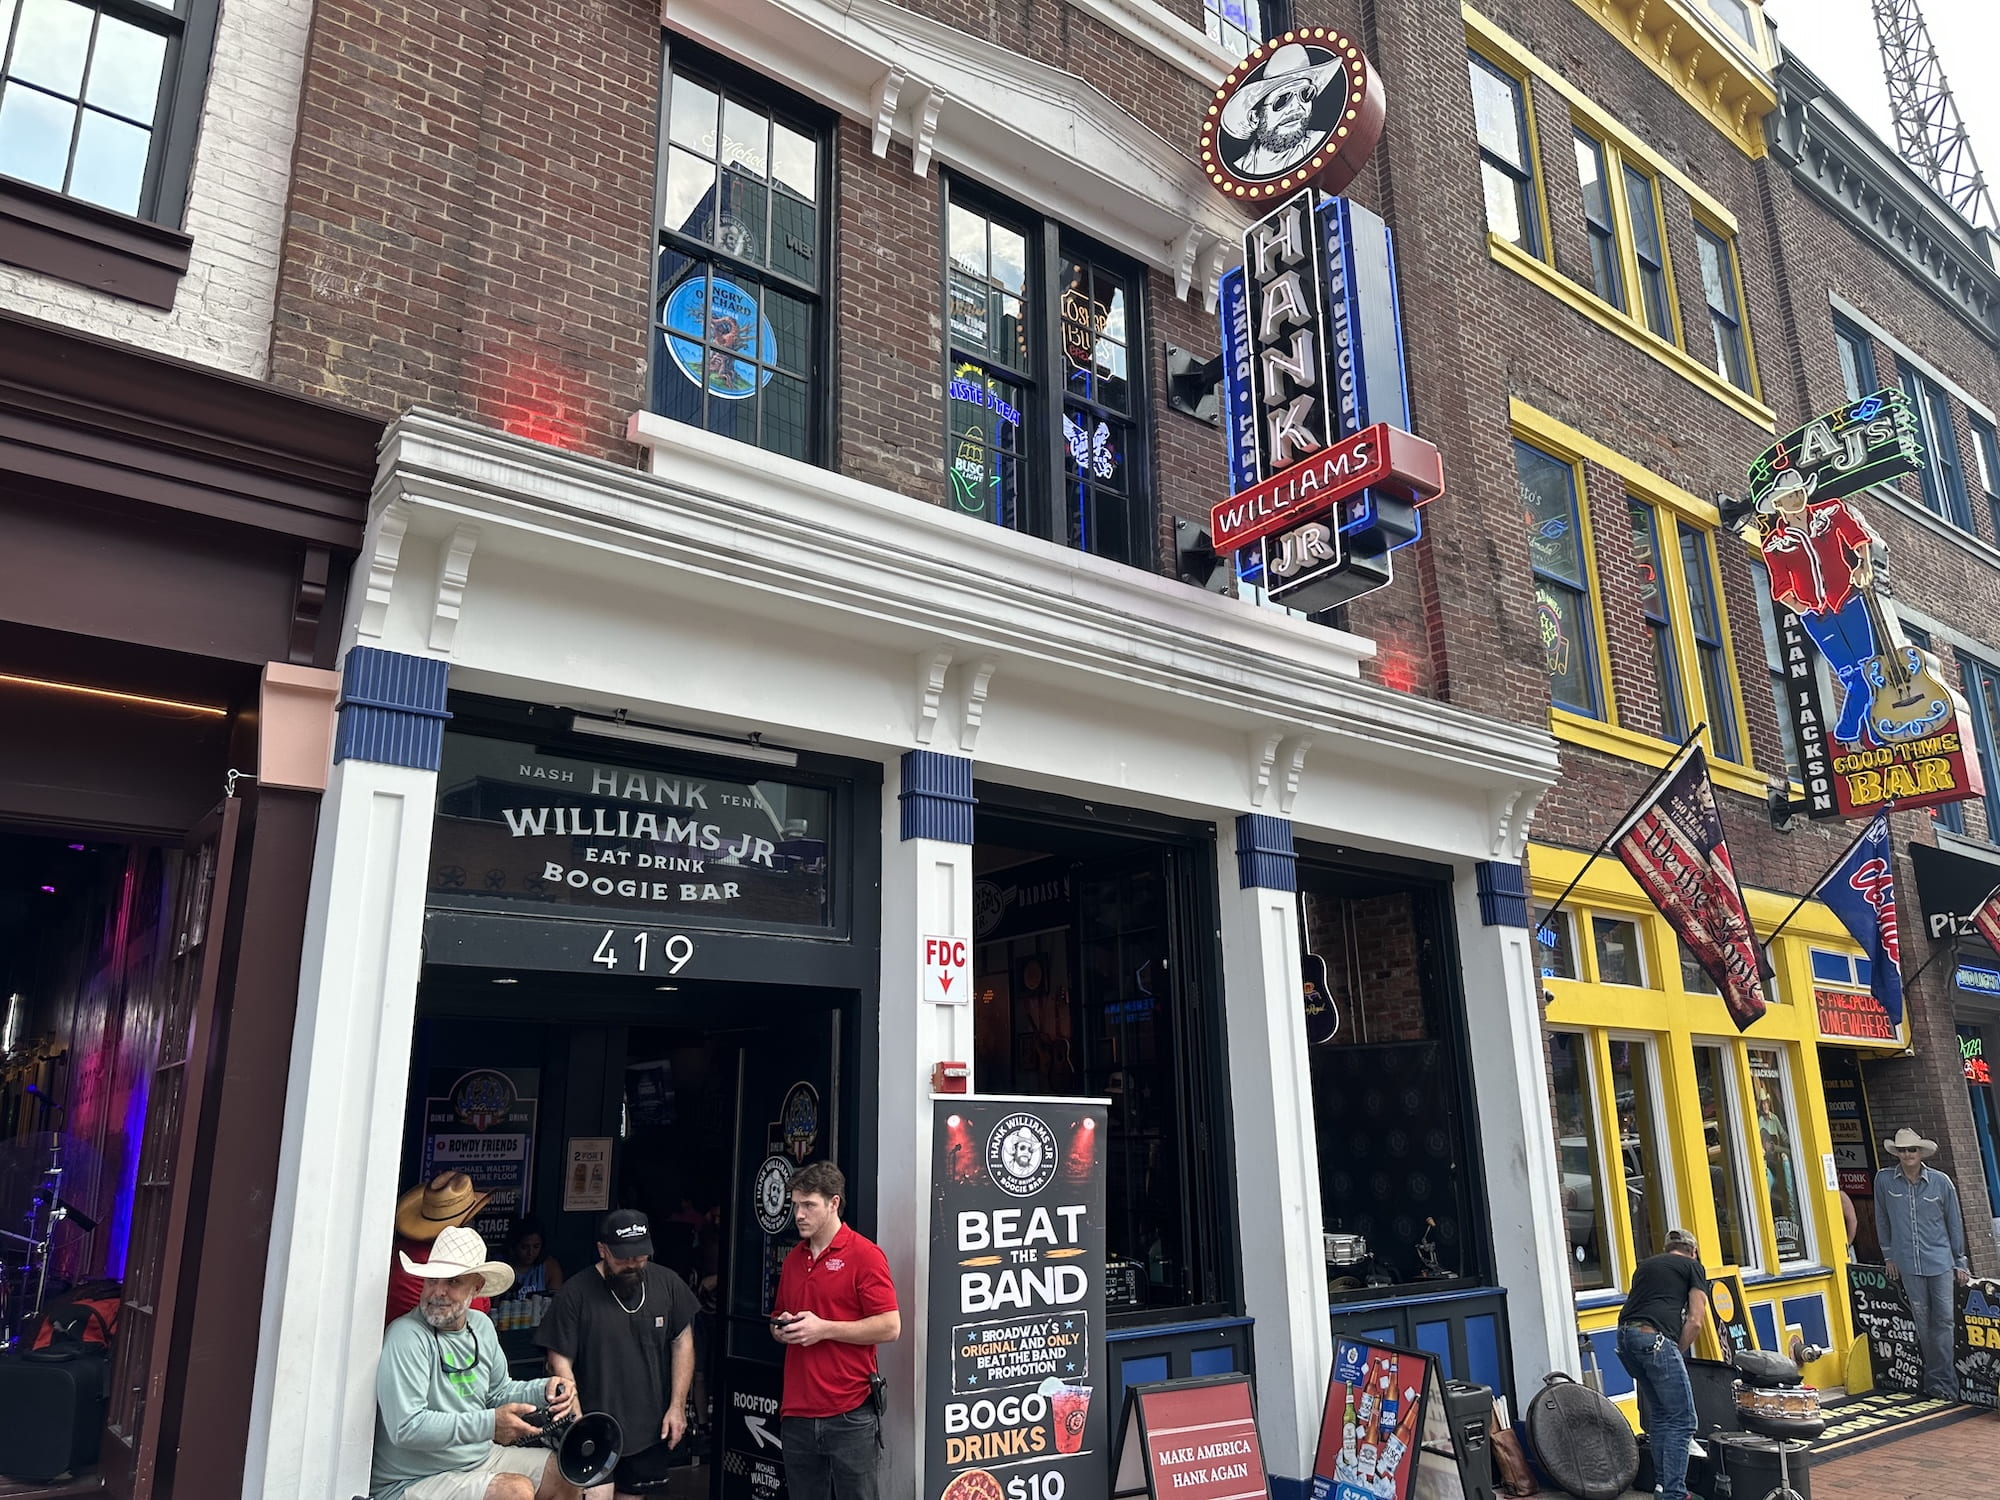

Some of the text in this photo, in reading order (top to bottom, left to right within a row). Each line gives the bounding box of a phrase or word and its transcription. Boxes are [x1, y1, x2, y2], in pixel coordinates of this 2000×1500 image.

[1327, 235, 1345, 295] BAR
[695, 289, 751, 317] OCHARD
[711, 285, 743, 304] NGRY
[1252, 203, 1321, 468] HANK
[1232, 300, 1255, 467] EAT DRINK
[994, 399, 1021, 427] TEA
[961, 470, 984, 484] LIGHT
[1219, 442, 1368, 534] WILLIAMS
[1519, 485, 1543, 506] ito's
[1270, 521, 1335, 578] JR
[1783, 612, 1808, 680] ALAN
[1799, 690, 1833, 812] JACKSON
[1833, 732, 1961, 775] GOOD TIME
[518, 763, 765, 811] NASH HANK TENN
[1846, 756, 1956, 807] BAR
[502, 806, 776, 869] WILLIAMS JR
[1644, 819, 1678, 872] We
[585, 846, 706, 875] EAT DRINK
[542, 861, 742, 902] BOOGIE BAR
[591, 928, 696, 975] 419
[926, 938, 966, 968] FDC
[1820, 1009, 1894, 1038] OMEWHERE
[508, 1112, 529, 1122] DRINK
[1839, 1121, 1858, 1132] BAR
[449, 1138, 518, 1152] ROWDY FRIENDS
[990, 1116, 1054, 1160] HANK WILLIAMS JR
[574, 1151, 581, 1161] 2
[485, 1164, 519, 1174] WALTRIP
[493, 1172, 518, 1181] FLOOR
[1843, 1173, 1866, 1183] TONK
[756, 1169, 767, 1199] HANK
[1000, 1176, 1046, 1194] BOOGIE BAR
[1845, 1182, 1865, 1190] MUSIC
[489, 1190, 516, 1205] OUNGE
[477, 1218, 510, 1233] STAGE
[957, 1204, 1088, 1252] BEAT
[1010, 1248, 1038, 1264] THE
[960, 1264, 1089, 1314] BAND
[1850, 1270, 1887, 1289] FOOD
[1854, 1290, 1905, 1313] 3 FLOOR
[982, 1317, 1060, 1344] BROADWAY'S
[1891, 1315, 1916, 1332] Sun
[1965, 1314, 1991, 1326] GOOD
[961, 1332, 1080, 1359] ORIGINAL AND ONLY
[1870, 1325, 1915, 1344] 6 CLOSE
[976, 1346, 1067, 1370] BEAT THE BAND
[1894, 1342, 1923, 1367] Busch
[1895, 1358, 1918, 1376] DOG
[987, 1360, 1057, 1381] PROMOTION
[1887, 1367, 1920, 1389] Chips
[733, 1391, 779, 1415] ROOFTOP
[1959, 1388, 1998, 1405] DOMEST
[944, 1392, 1048, 1434] BOGO
[1380, 1417, 1397, 1427] LIGHT
[1382, 1410, 1396, 1420] BUD
[945, 1425, 1047, 1466] DRINKS
[1158, 1439, 1252, 1467] MAKE AMERICA
[755, 1461, 777, 1475] MICHAEL
[1172, 1462, 1248, 1488] HANK AGAIN
[750, 1472, 781, 1491] WALTRIP
[1006, 1470, 1066, 1500] $10
